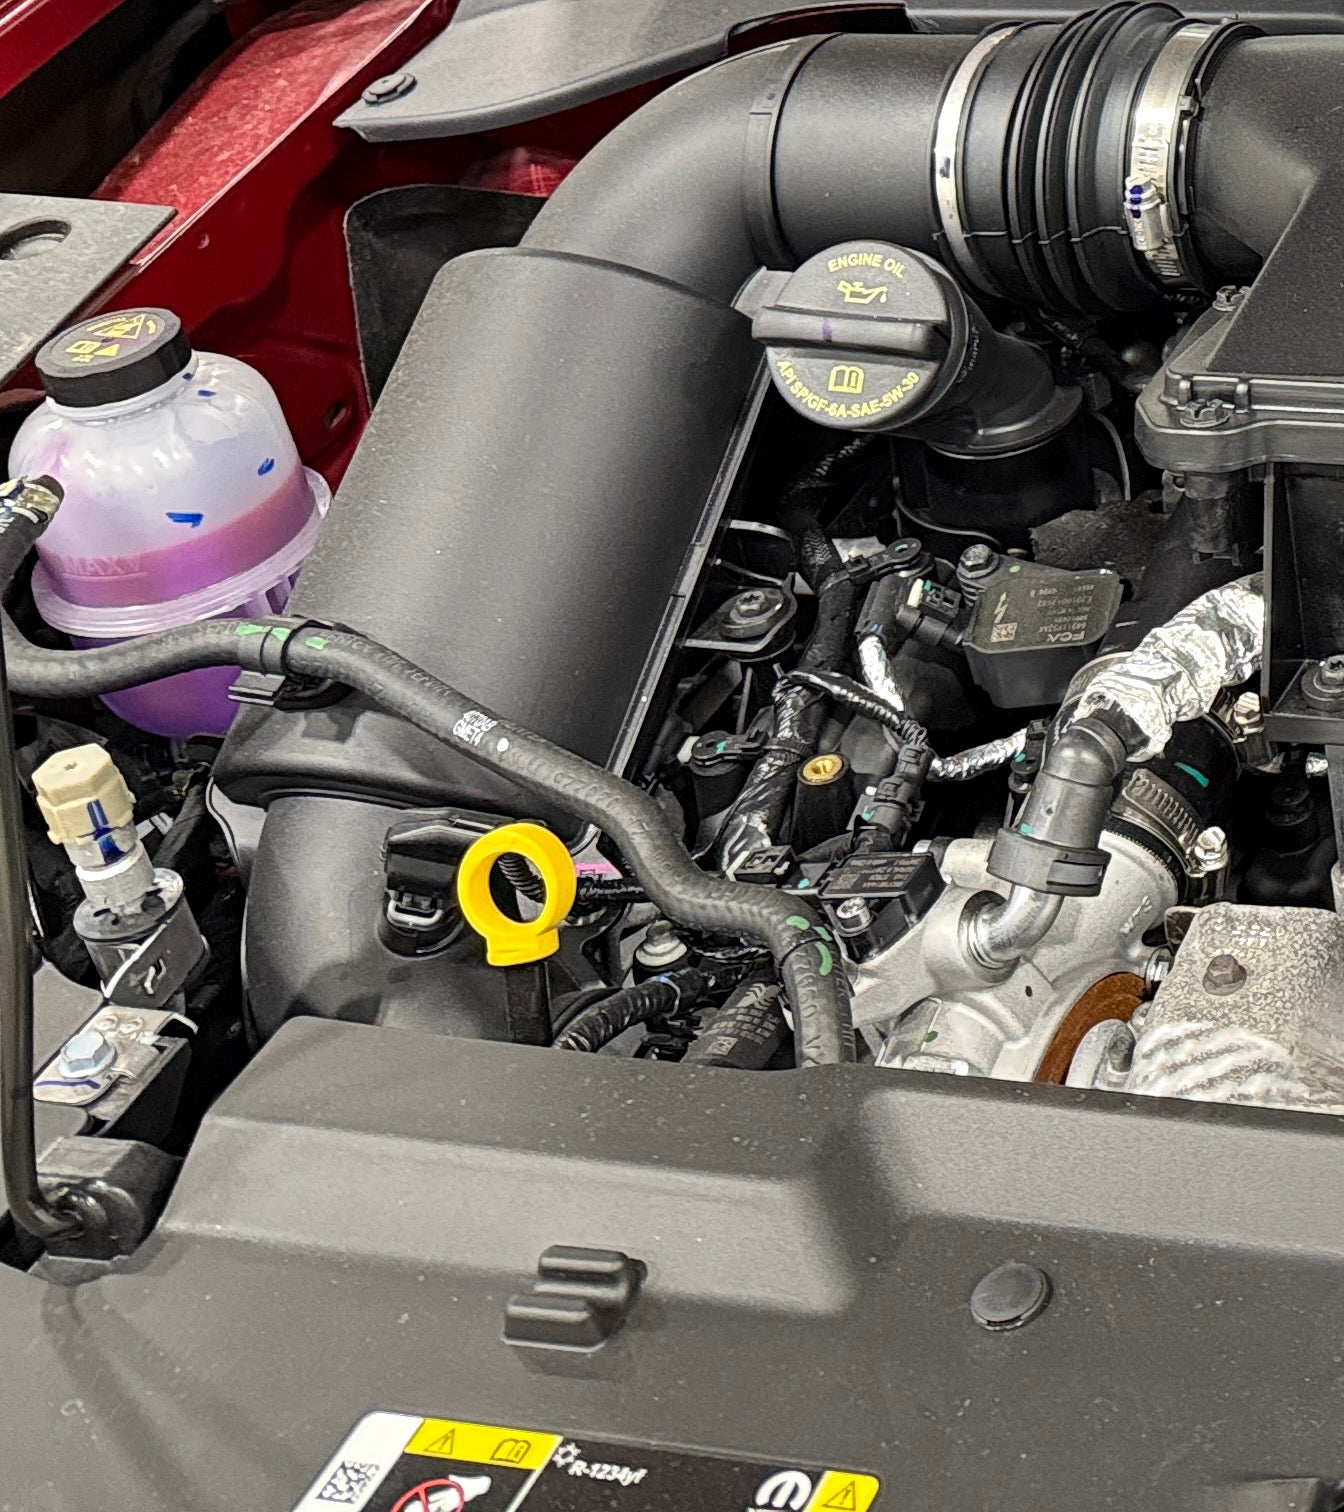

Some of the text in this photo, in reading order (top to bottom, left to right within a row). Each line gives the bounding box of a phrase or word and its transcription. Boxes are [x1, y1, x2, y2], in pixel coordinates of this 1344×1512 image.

[827, 253, 906, 279] ENGINE OIL
[777, 360, 793, 387] API
[1047, 631, 1086, 643] FCA
